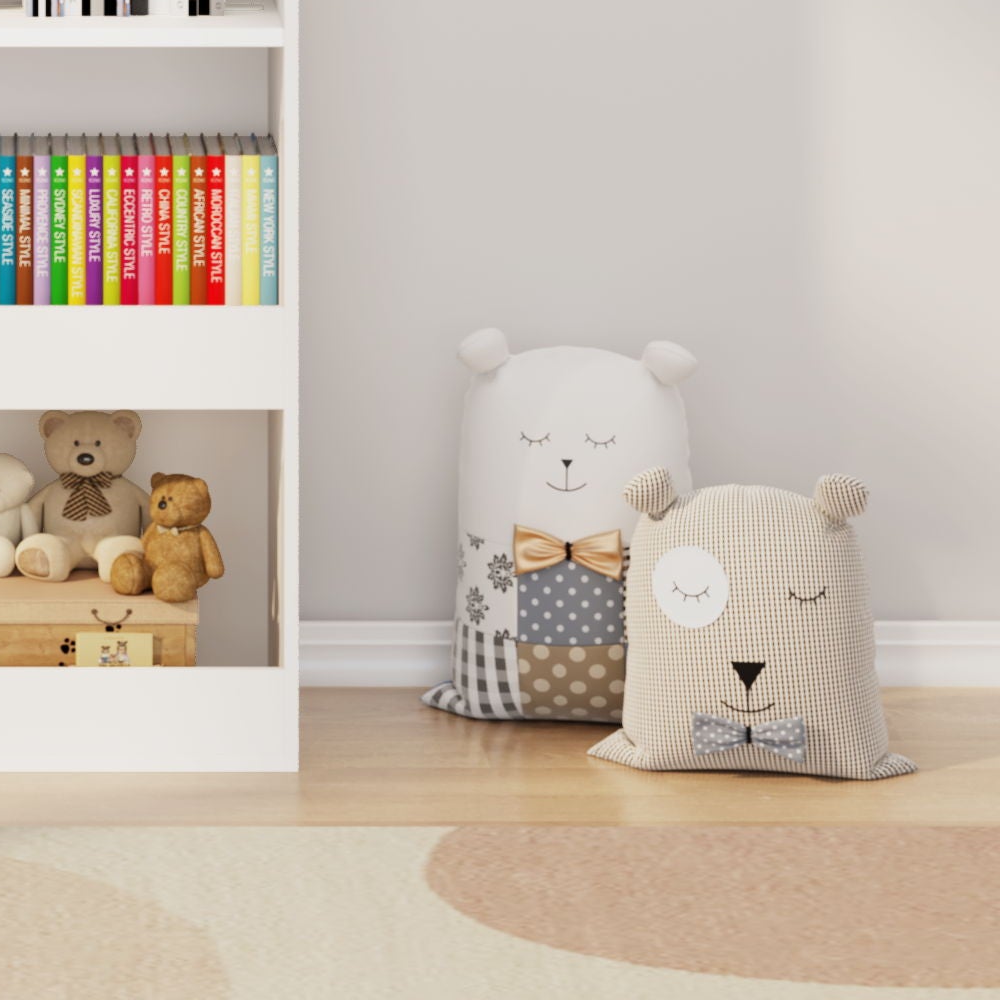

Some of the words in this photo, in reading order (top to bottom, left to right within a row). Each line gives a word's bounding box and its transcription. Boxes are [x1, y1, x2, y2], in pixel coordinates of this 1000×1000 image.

[2, 189, 14, 232] SEASIDE
[19, 189, 31, 233] MINIMAL
[37, 189, 48, 244] PROVENCE
[54, 189, 66, 229] SYDNEY
[89, 189, 101, 228] LUXURY
[141, 189, 153, 223] RETRO
[159, 189, 171, 221] CHINA
[176, 189, 189, 237] COUNTRY
[194, 189, 206, 233] AFRICAN
[263, 189, 275, 213] NEW
[107, 189, 119, 249] CALIFORNIA
[123, 189, 136, 246] ECCENTRIC
[211, 189, 223, 250] MOROCCAN
[263, 215, 275, 243] YORK
[2, 234, 14, 265] STYLE
[19, 236, 31, 267] STYLE
[54, 231, 66, 262] STYLE
[89, 230, 101, 262] STYLE
[141, 226, 153, 257] STYLE
[159, 223, 171, 254] STYLE
[194, 235, 206, 267] STYLE
[246, 223, 258, 254] STYLE
[36, 246, 48, 277] STYLE
[107, 252, 119, 282] STYLE
[123, 248, 136, 279] STYLE
[176, 240, 189, 271] STYLE
[211, 252, 223, 283] STYLE
[263, 246, 275, 276] STYLE
[72, 267, 84, 297] STYLE
